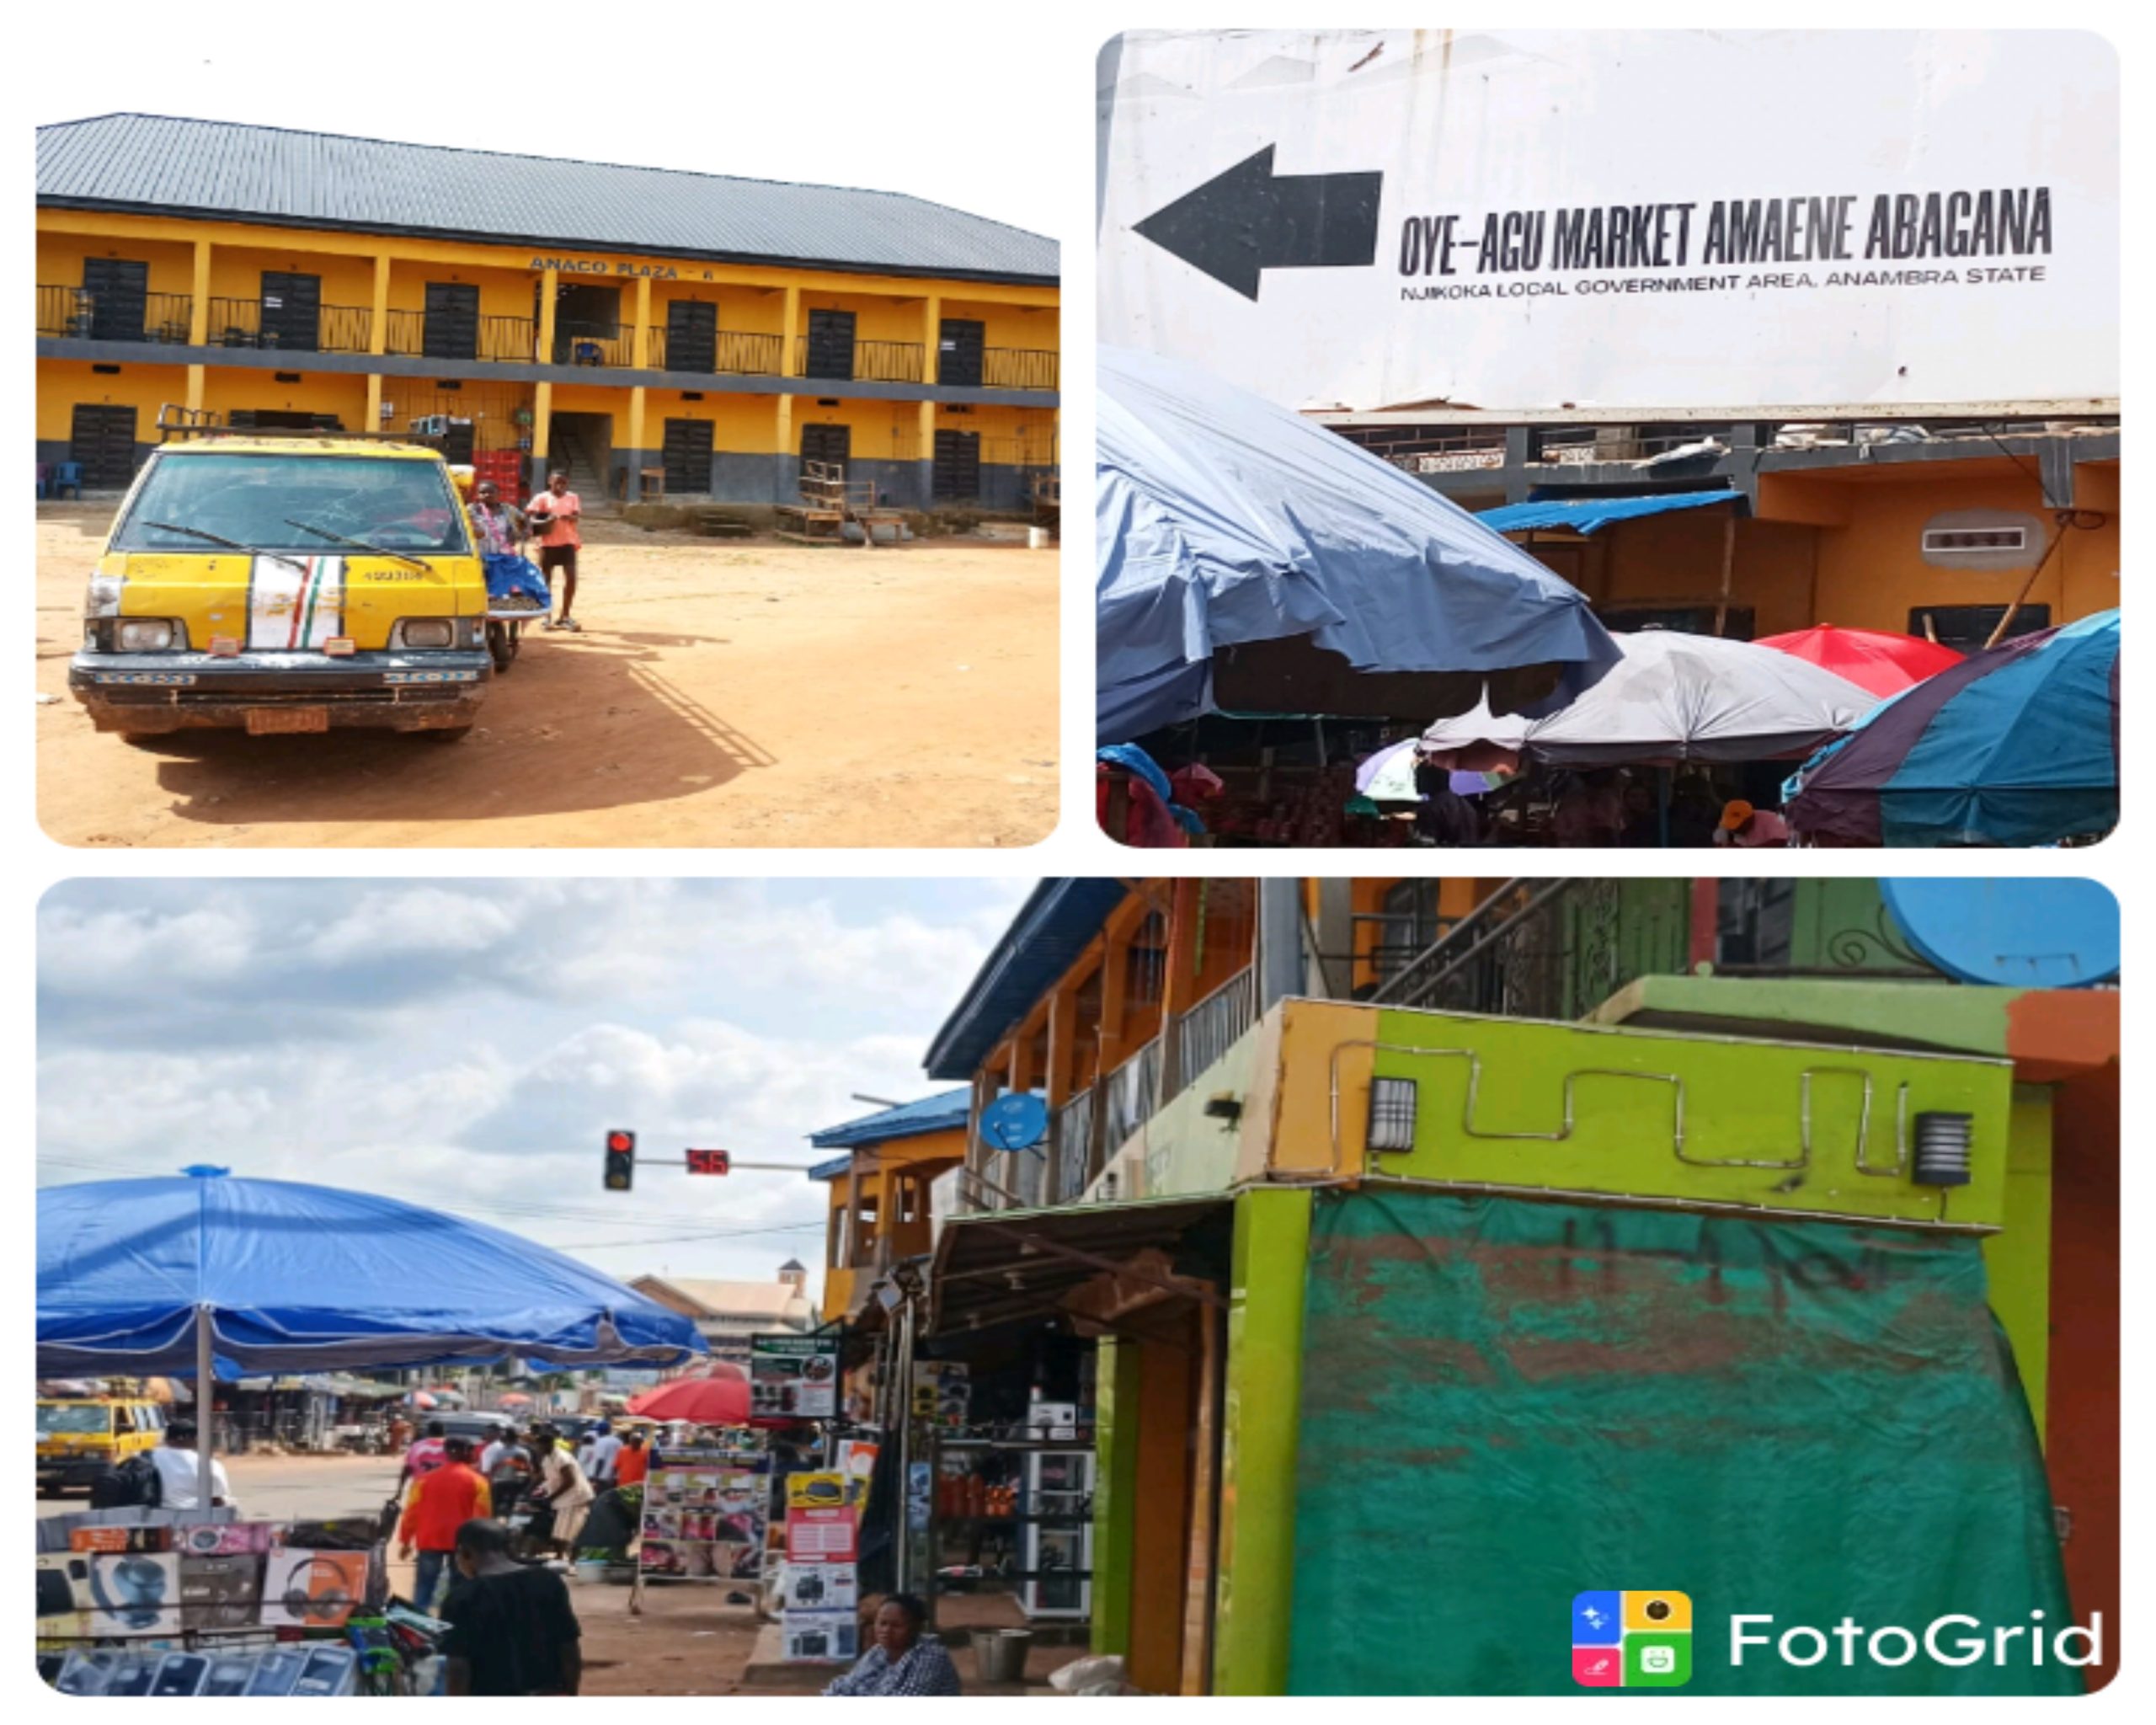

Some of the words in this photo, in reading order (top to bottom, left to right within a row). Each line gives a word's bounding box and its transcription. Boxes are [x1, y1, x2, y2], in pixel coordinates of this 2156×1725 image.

[1399, 211, 1545, 276] OYE-AGU
[1551, 203, 1696, 270] MARKET
[1703, 196, 1856, 264] AMAENE
[1865, 187, 2052, 259] ABAGANA
[531, 256, 606, 274] ANACO
[616, 262, 677, 280] PLAZA
[1401, 284, 1492, 301] NJIKOKA
[1496, 281, 1569, 298] LOCAL
[1574, 275, 1742, 296] GOVERNMENT
[1826, 270, 1959, 286] ANAMBRA
[1967, 265, 2045, 284] STATE
